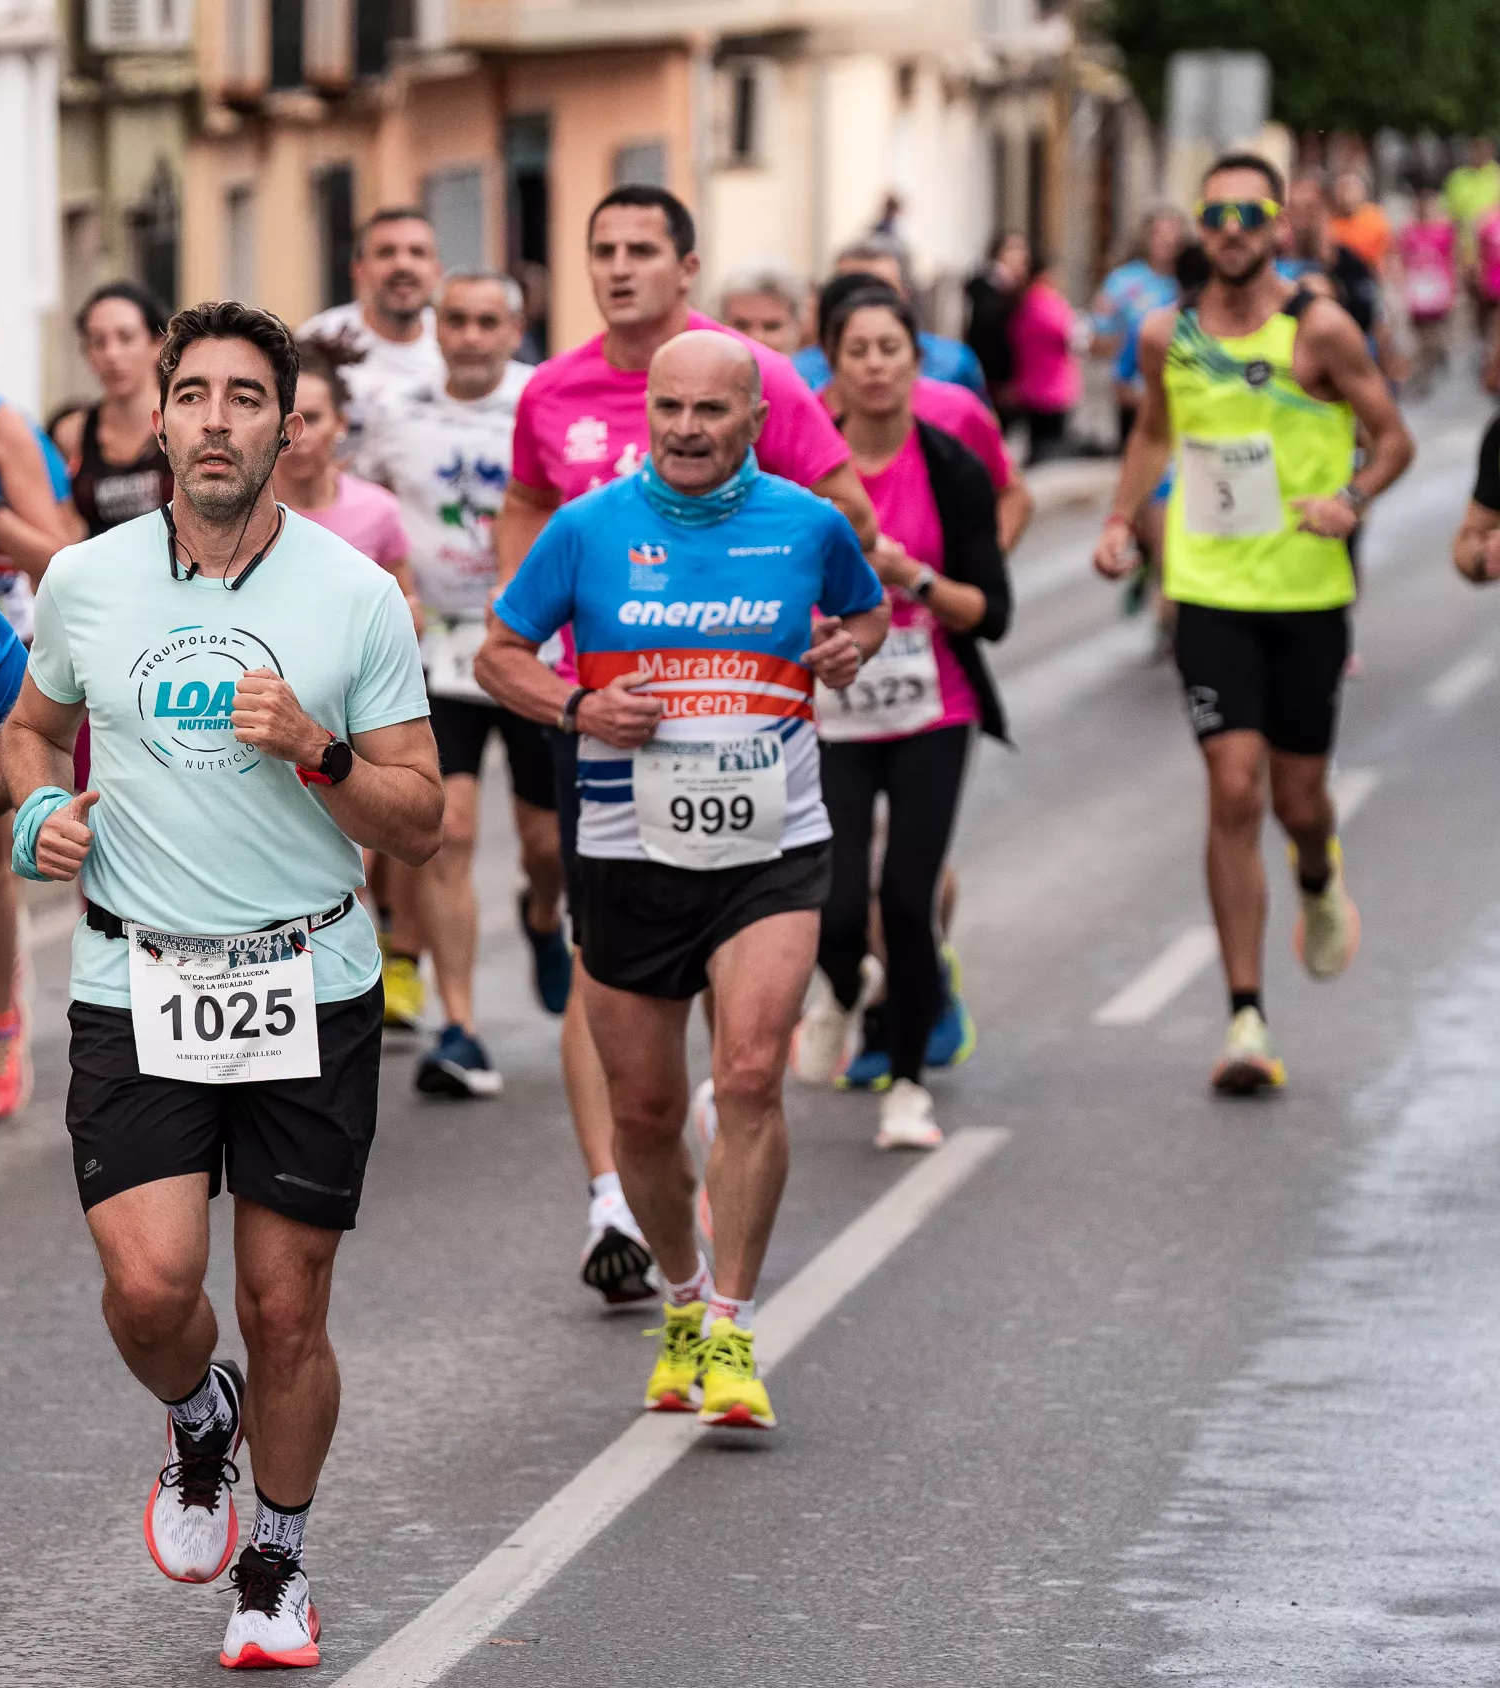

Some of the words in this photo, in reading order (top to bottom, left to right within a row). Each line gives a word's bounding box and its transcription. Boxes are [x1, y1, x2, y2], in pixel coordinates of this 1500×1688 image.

[618, 595, 783, 633] enerplus
[141, 635, 227, 677] #EQUIPOLOA
[637, 651, 758, 680] Maratón
[153, 681, 236, 717] LOA
[661, 694, 748, 718] ucena
[185, 742, 255, 771] NUTRICIÓ
[670, 795, 754, 834] 999
[136, 930, 169, 942] CIRCUITO
[170, 936, 213, 947] PROVINCIAL
[179, 943, 224, 954] POPULARES
[225, 932, 273, 952] 2024
[205, 973, 231, 981] CIUDAD
[242, 969, 270, 977] LUCENA
[217, 979, 253, 989] IGUALDAD
[160, 988, 296, 1042] 1025
[175, 1053, 210, 1061] ALBERTO
[211, 1052, 235, 1061] PÉREZ
[236, 1049, 282, 1059] CABALLERO
